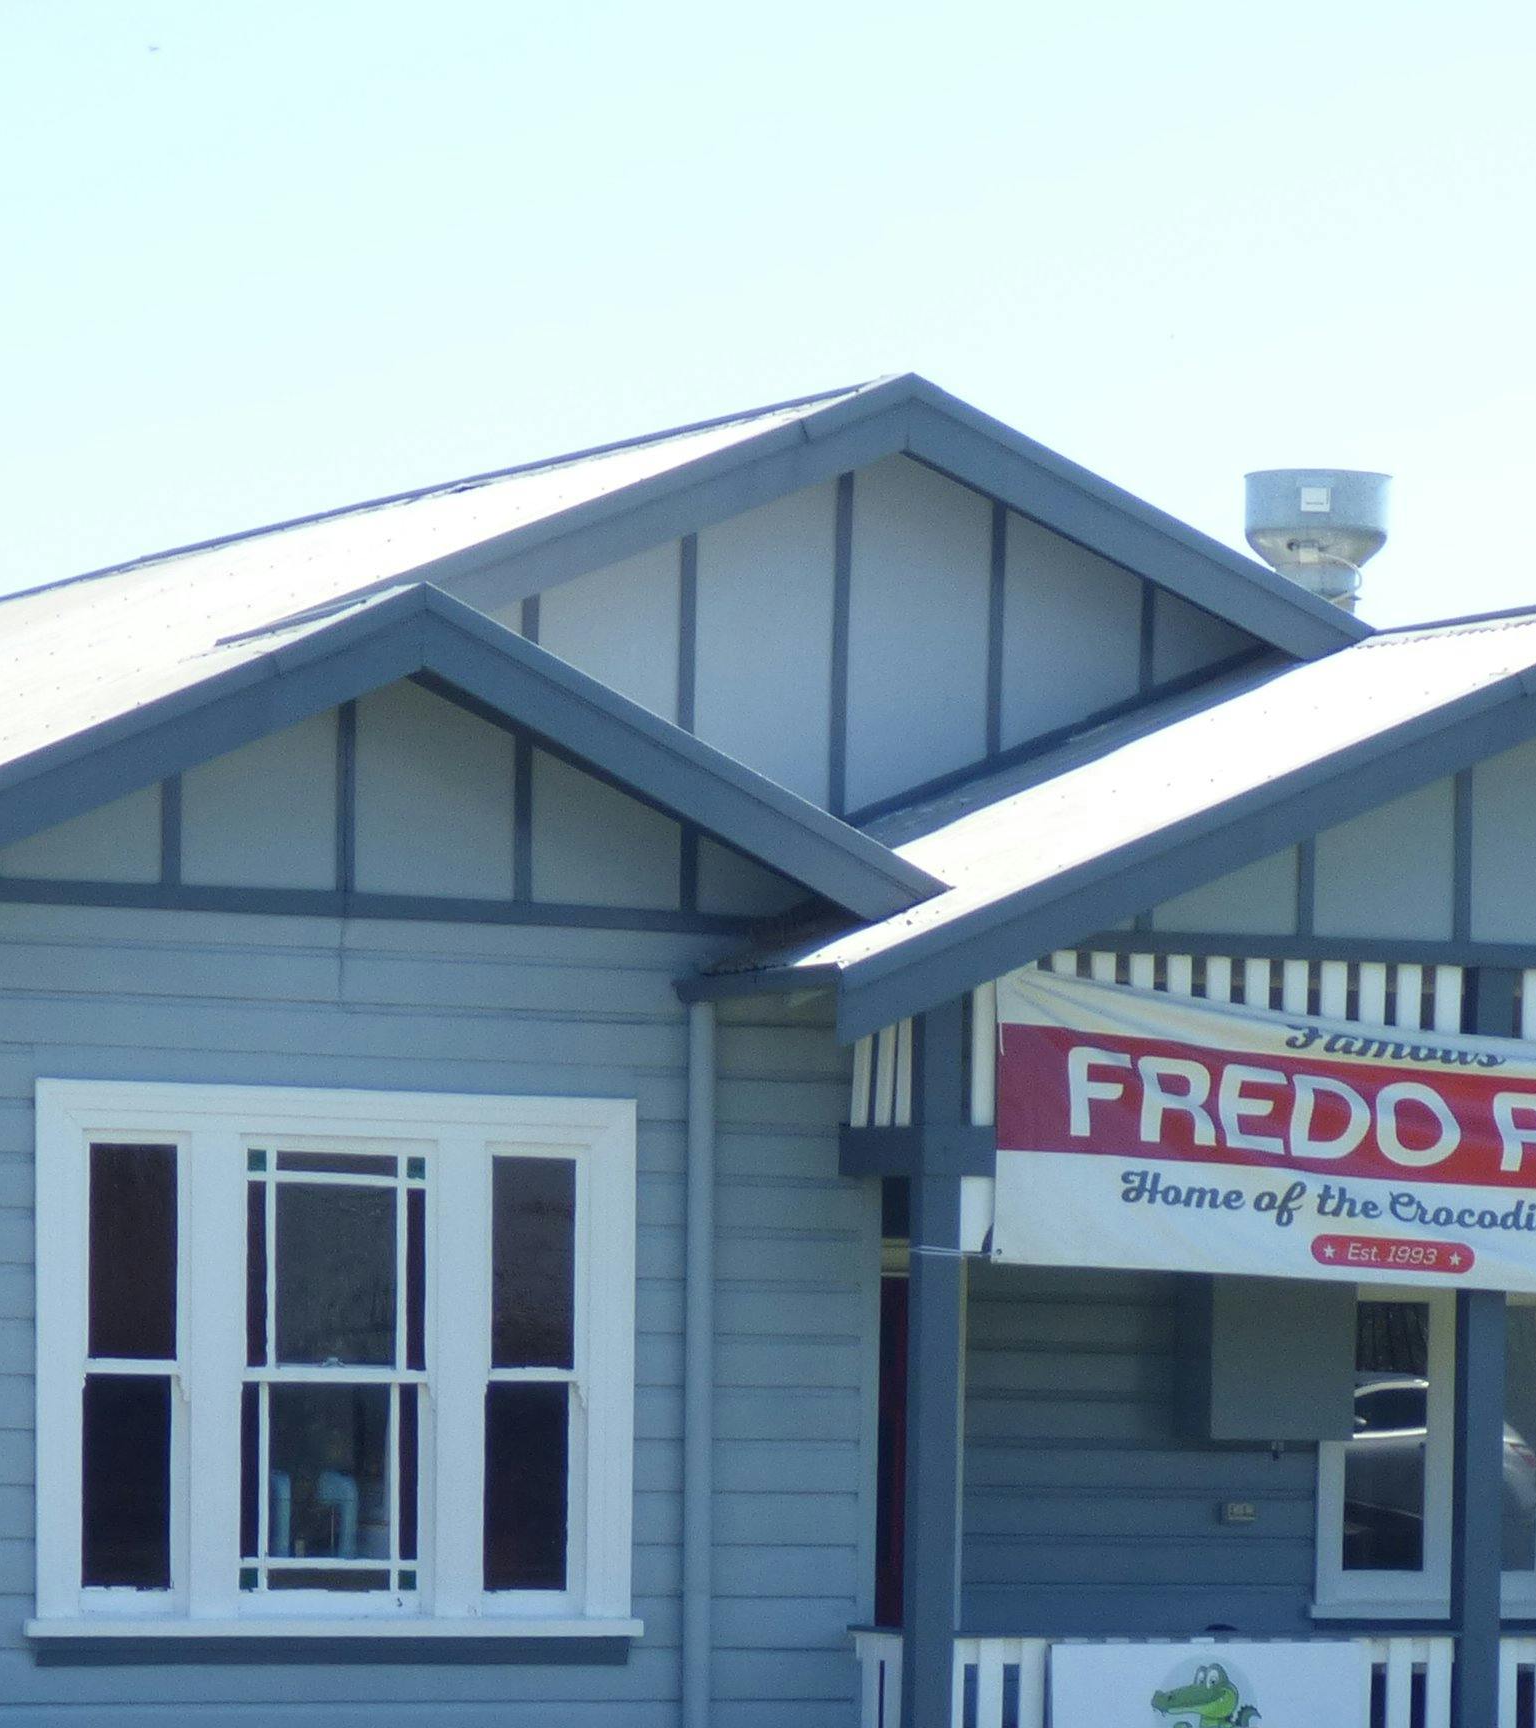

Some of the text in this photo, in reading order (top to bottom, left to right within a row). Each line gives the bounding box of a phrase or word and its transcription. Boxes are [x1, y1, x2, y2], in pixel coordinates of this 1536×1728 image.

[1285, 1024, 1506, 1068] Famous
[1068, 1046, 1462, 1167] FREDO
[1121, 1170, 1246, 1210] Home
[1253, 1181, 1307, 1227] of
[1317, 1184, 1383, 1219] the
[1347, 1243, 1438, 1265] Est. 1993
